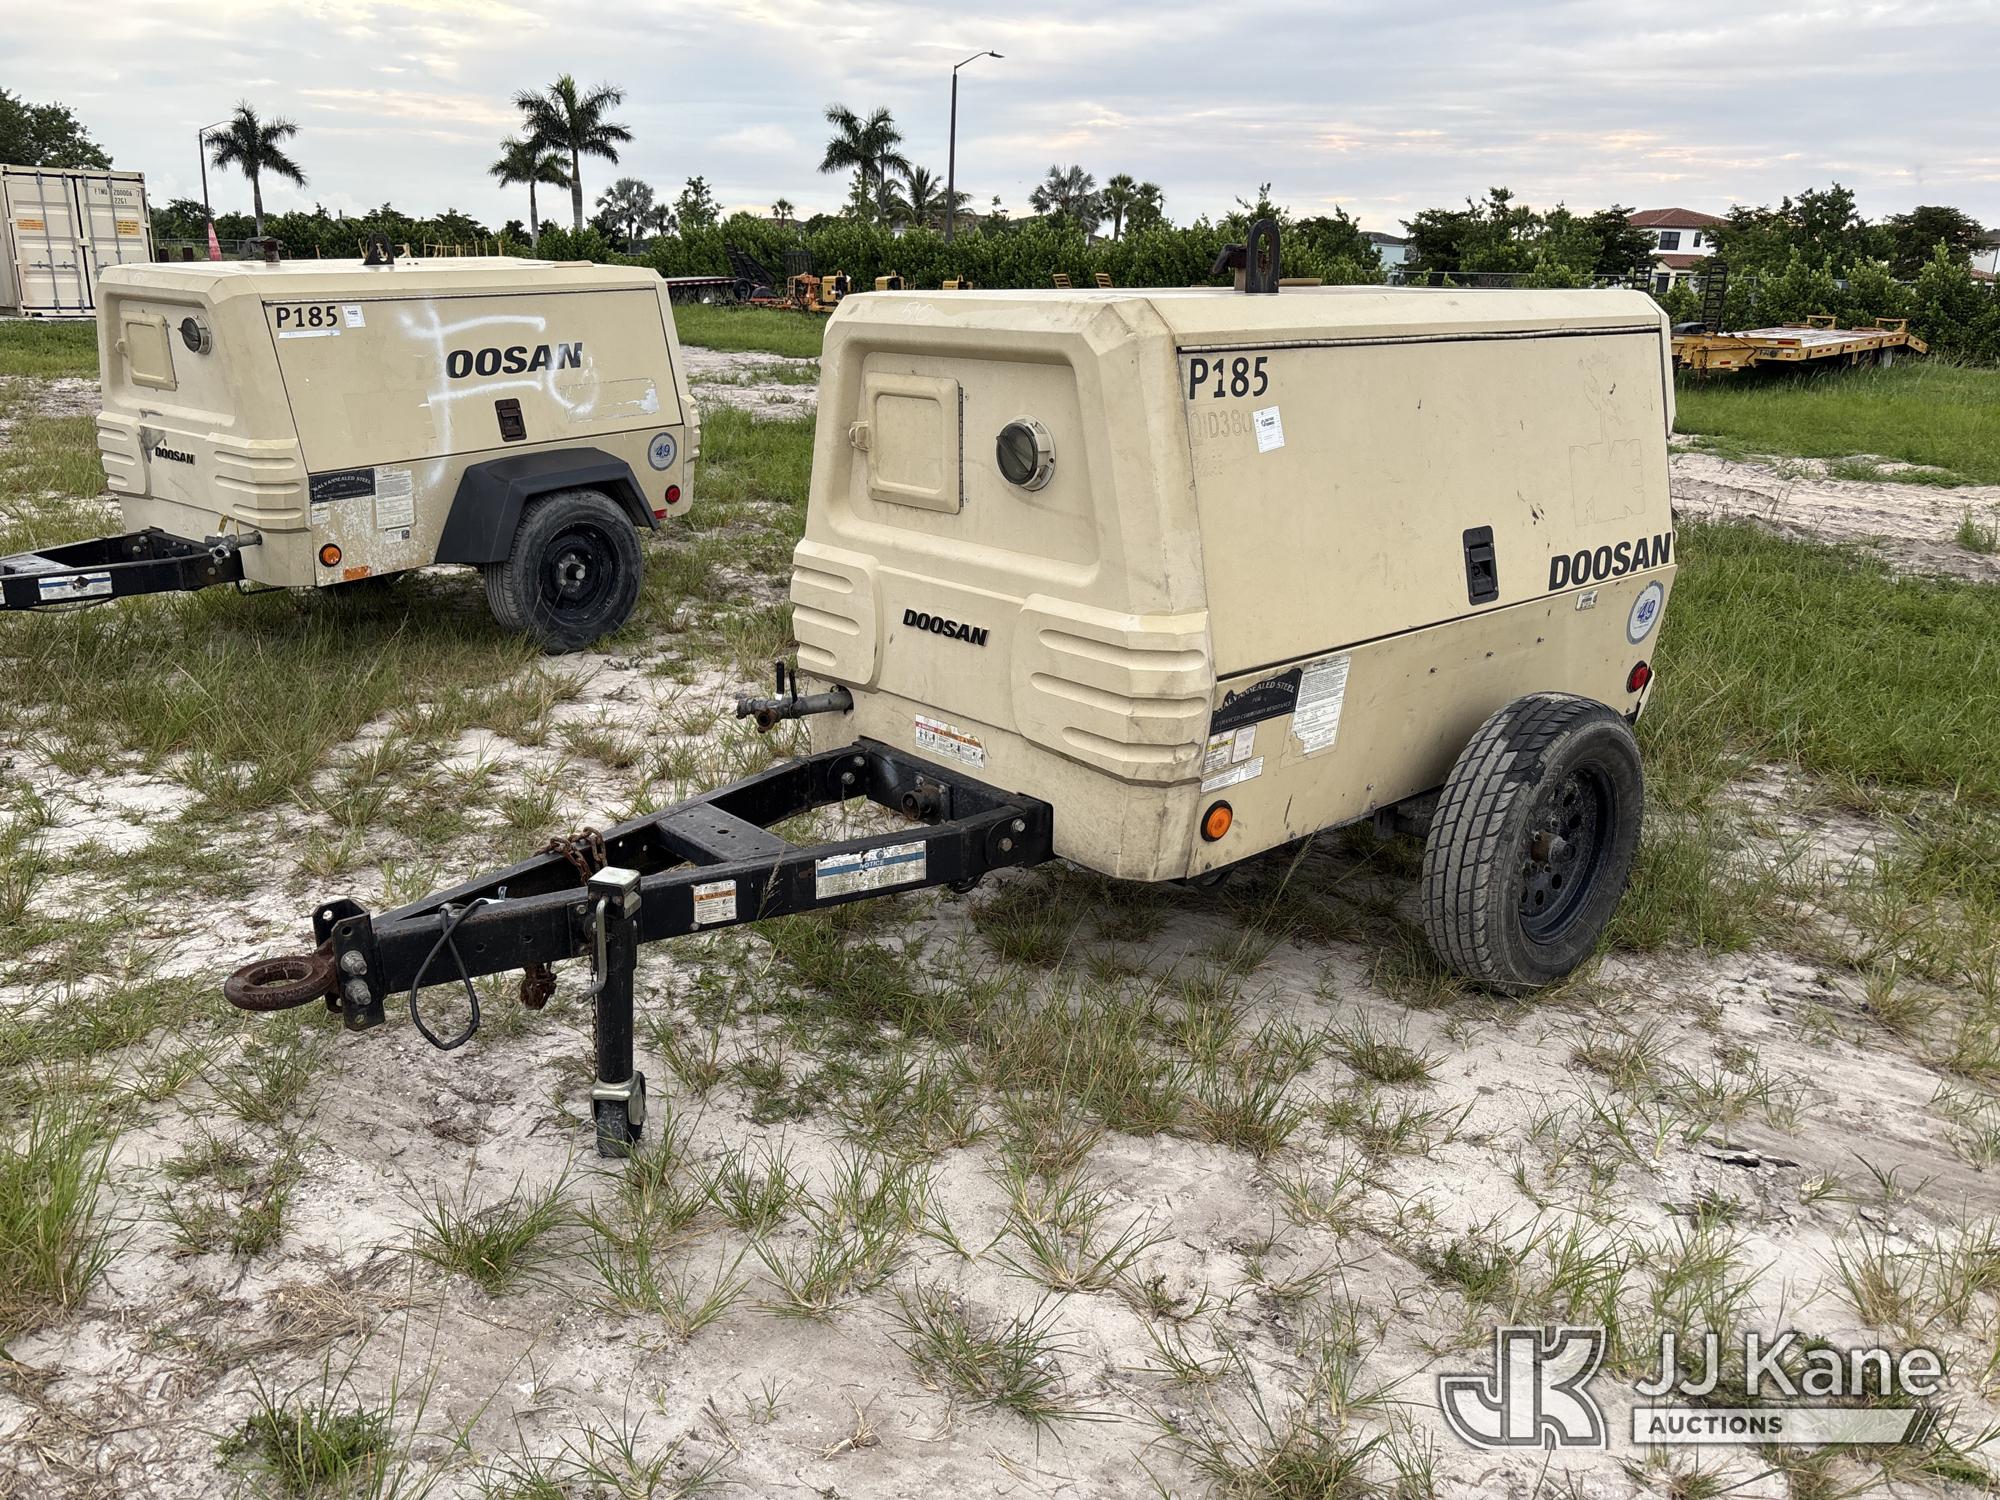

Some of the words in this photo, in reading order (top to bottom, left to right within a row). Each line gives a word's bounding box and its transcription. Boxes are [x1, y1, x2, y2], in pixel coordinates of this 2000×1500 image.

[276, 306, 338, 328] P185
[1189, 356, 1268, 400] P185
[155, 446, 196, 465] DOOSAN
[1548, 532, 1672, 591] DOOSAN
[903, 608, 989, 647] DOOSAN
[1276, 681, 1295, 694] STEEL
[860, 860, 885, 870] NOTICE
